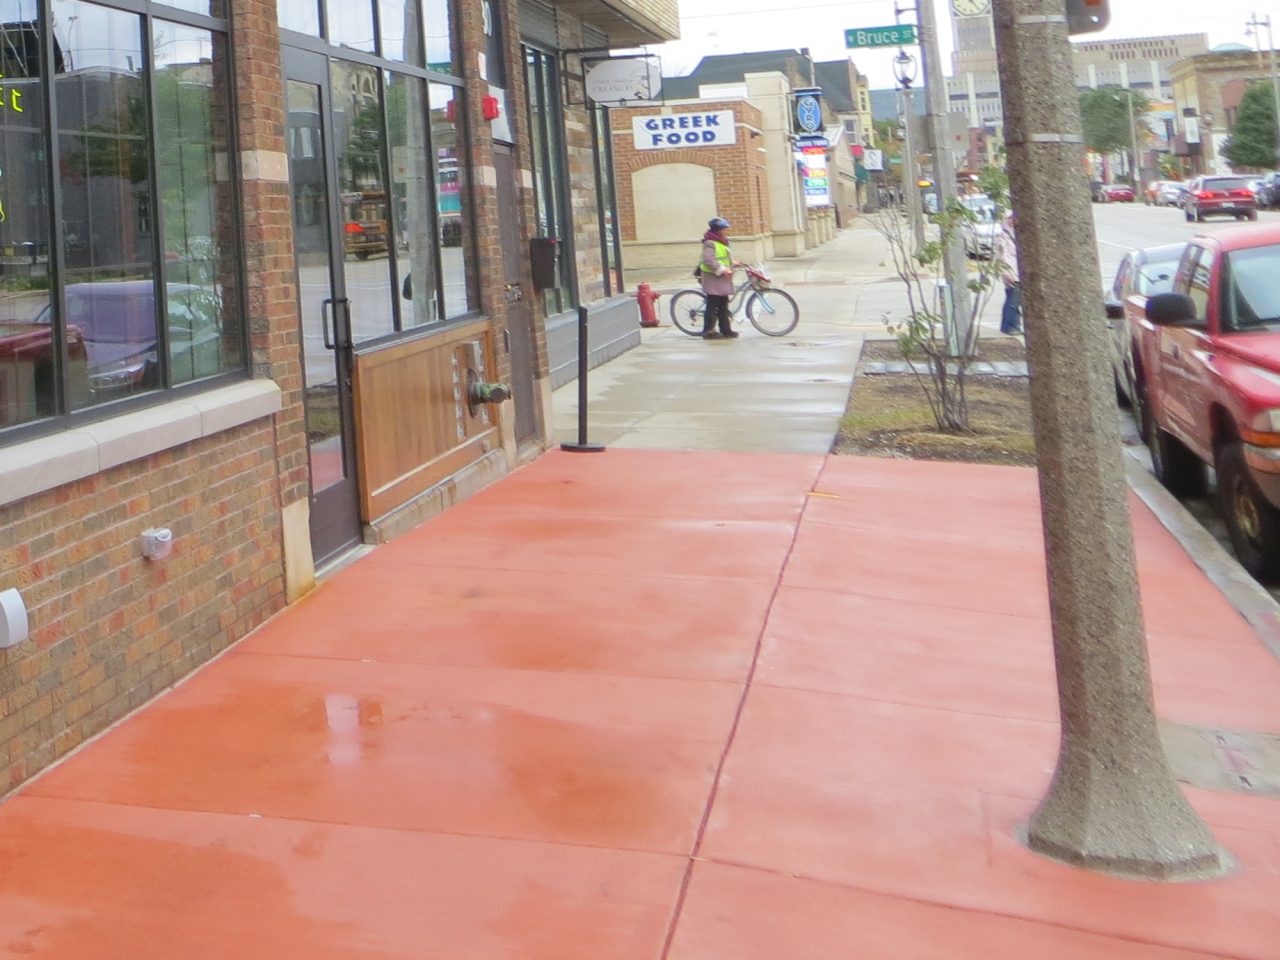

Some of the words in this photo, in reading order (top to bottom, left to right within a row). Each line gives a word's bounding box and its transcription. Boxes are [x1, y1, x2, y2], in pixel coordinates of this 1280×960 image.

[856, 31, 900, 45] Bruce
[645, 115, 719, 130] GREEK
[652, 130, 716, 146] FOOD
